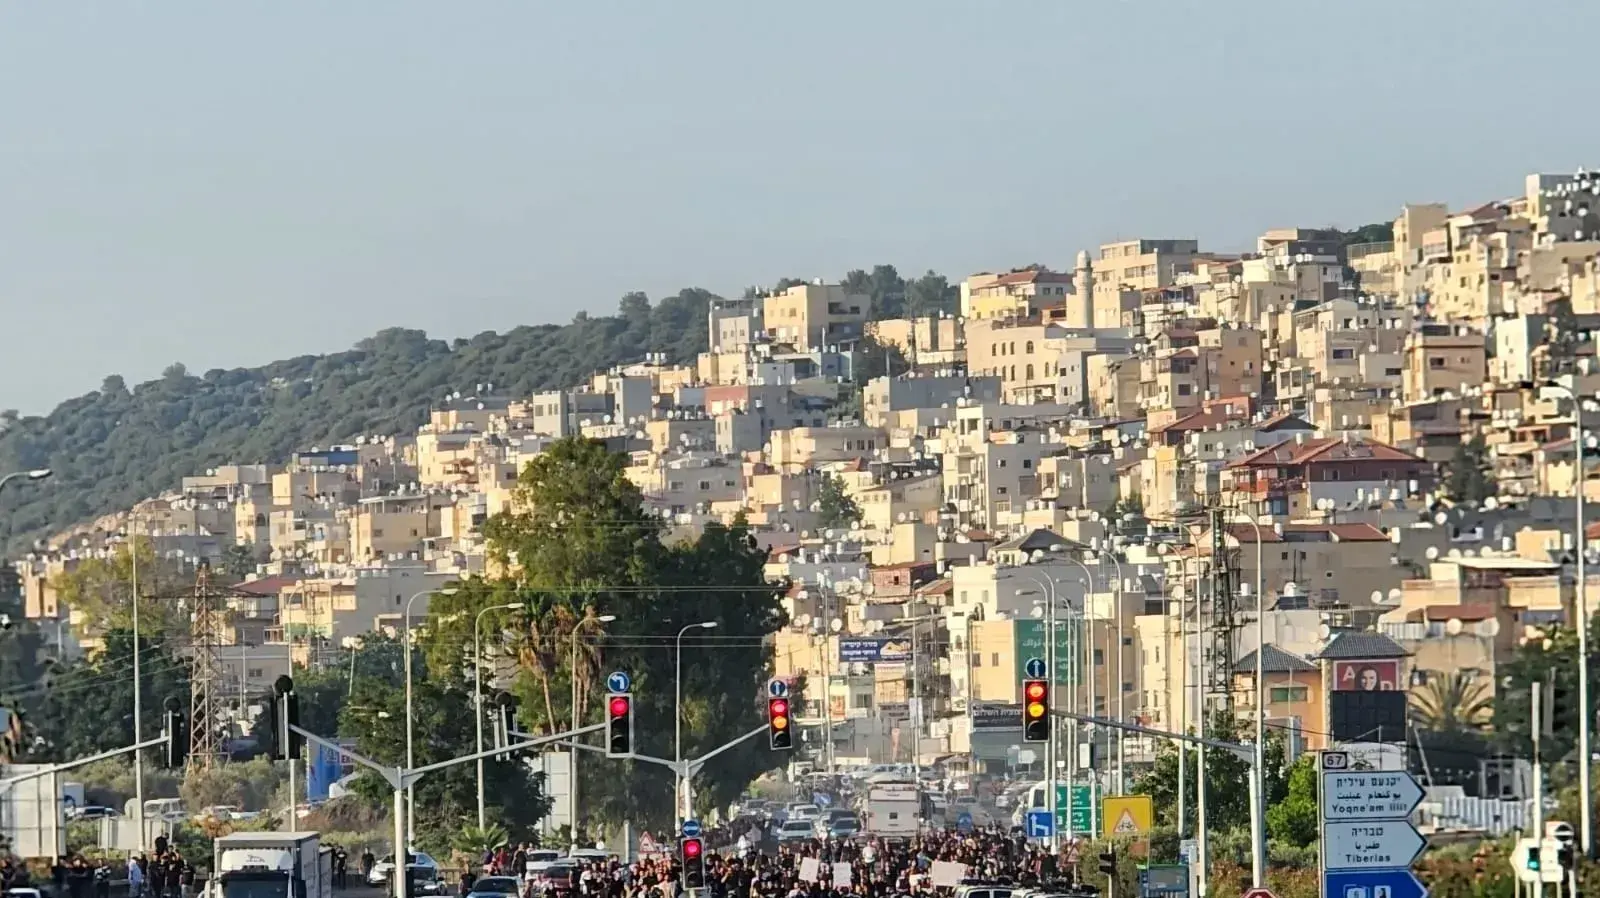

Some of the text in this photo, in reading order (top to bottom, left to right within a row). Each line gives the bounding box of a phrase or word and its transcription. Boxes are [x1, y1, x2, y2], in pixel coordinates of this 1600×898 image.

[1343, 665, 1355, 682] A
[1326, 755, 1344, 766] 67
[1336, 777, 1400, 788] יקנעם עילית
[1332, 803, 1384, 814] Yoqne'am
[1351, 827, 1384, 836] טבריה
[1345, 854, 1391, 863] Tiberias
